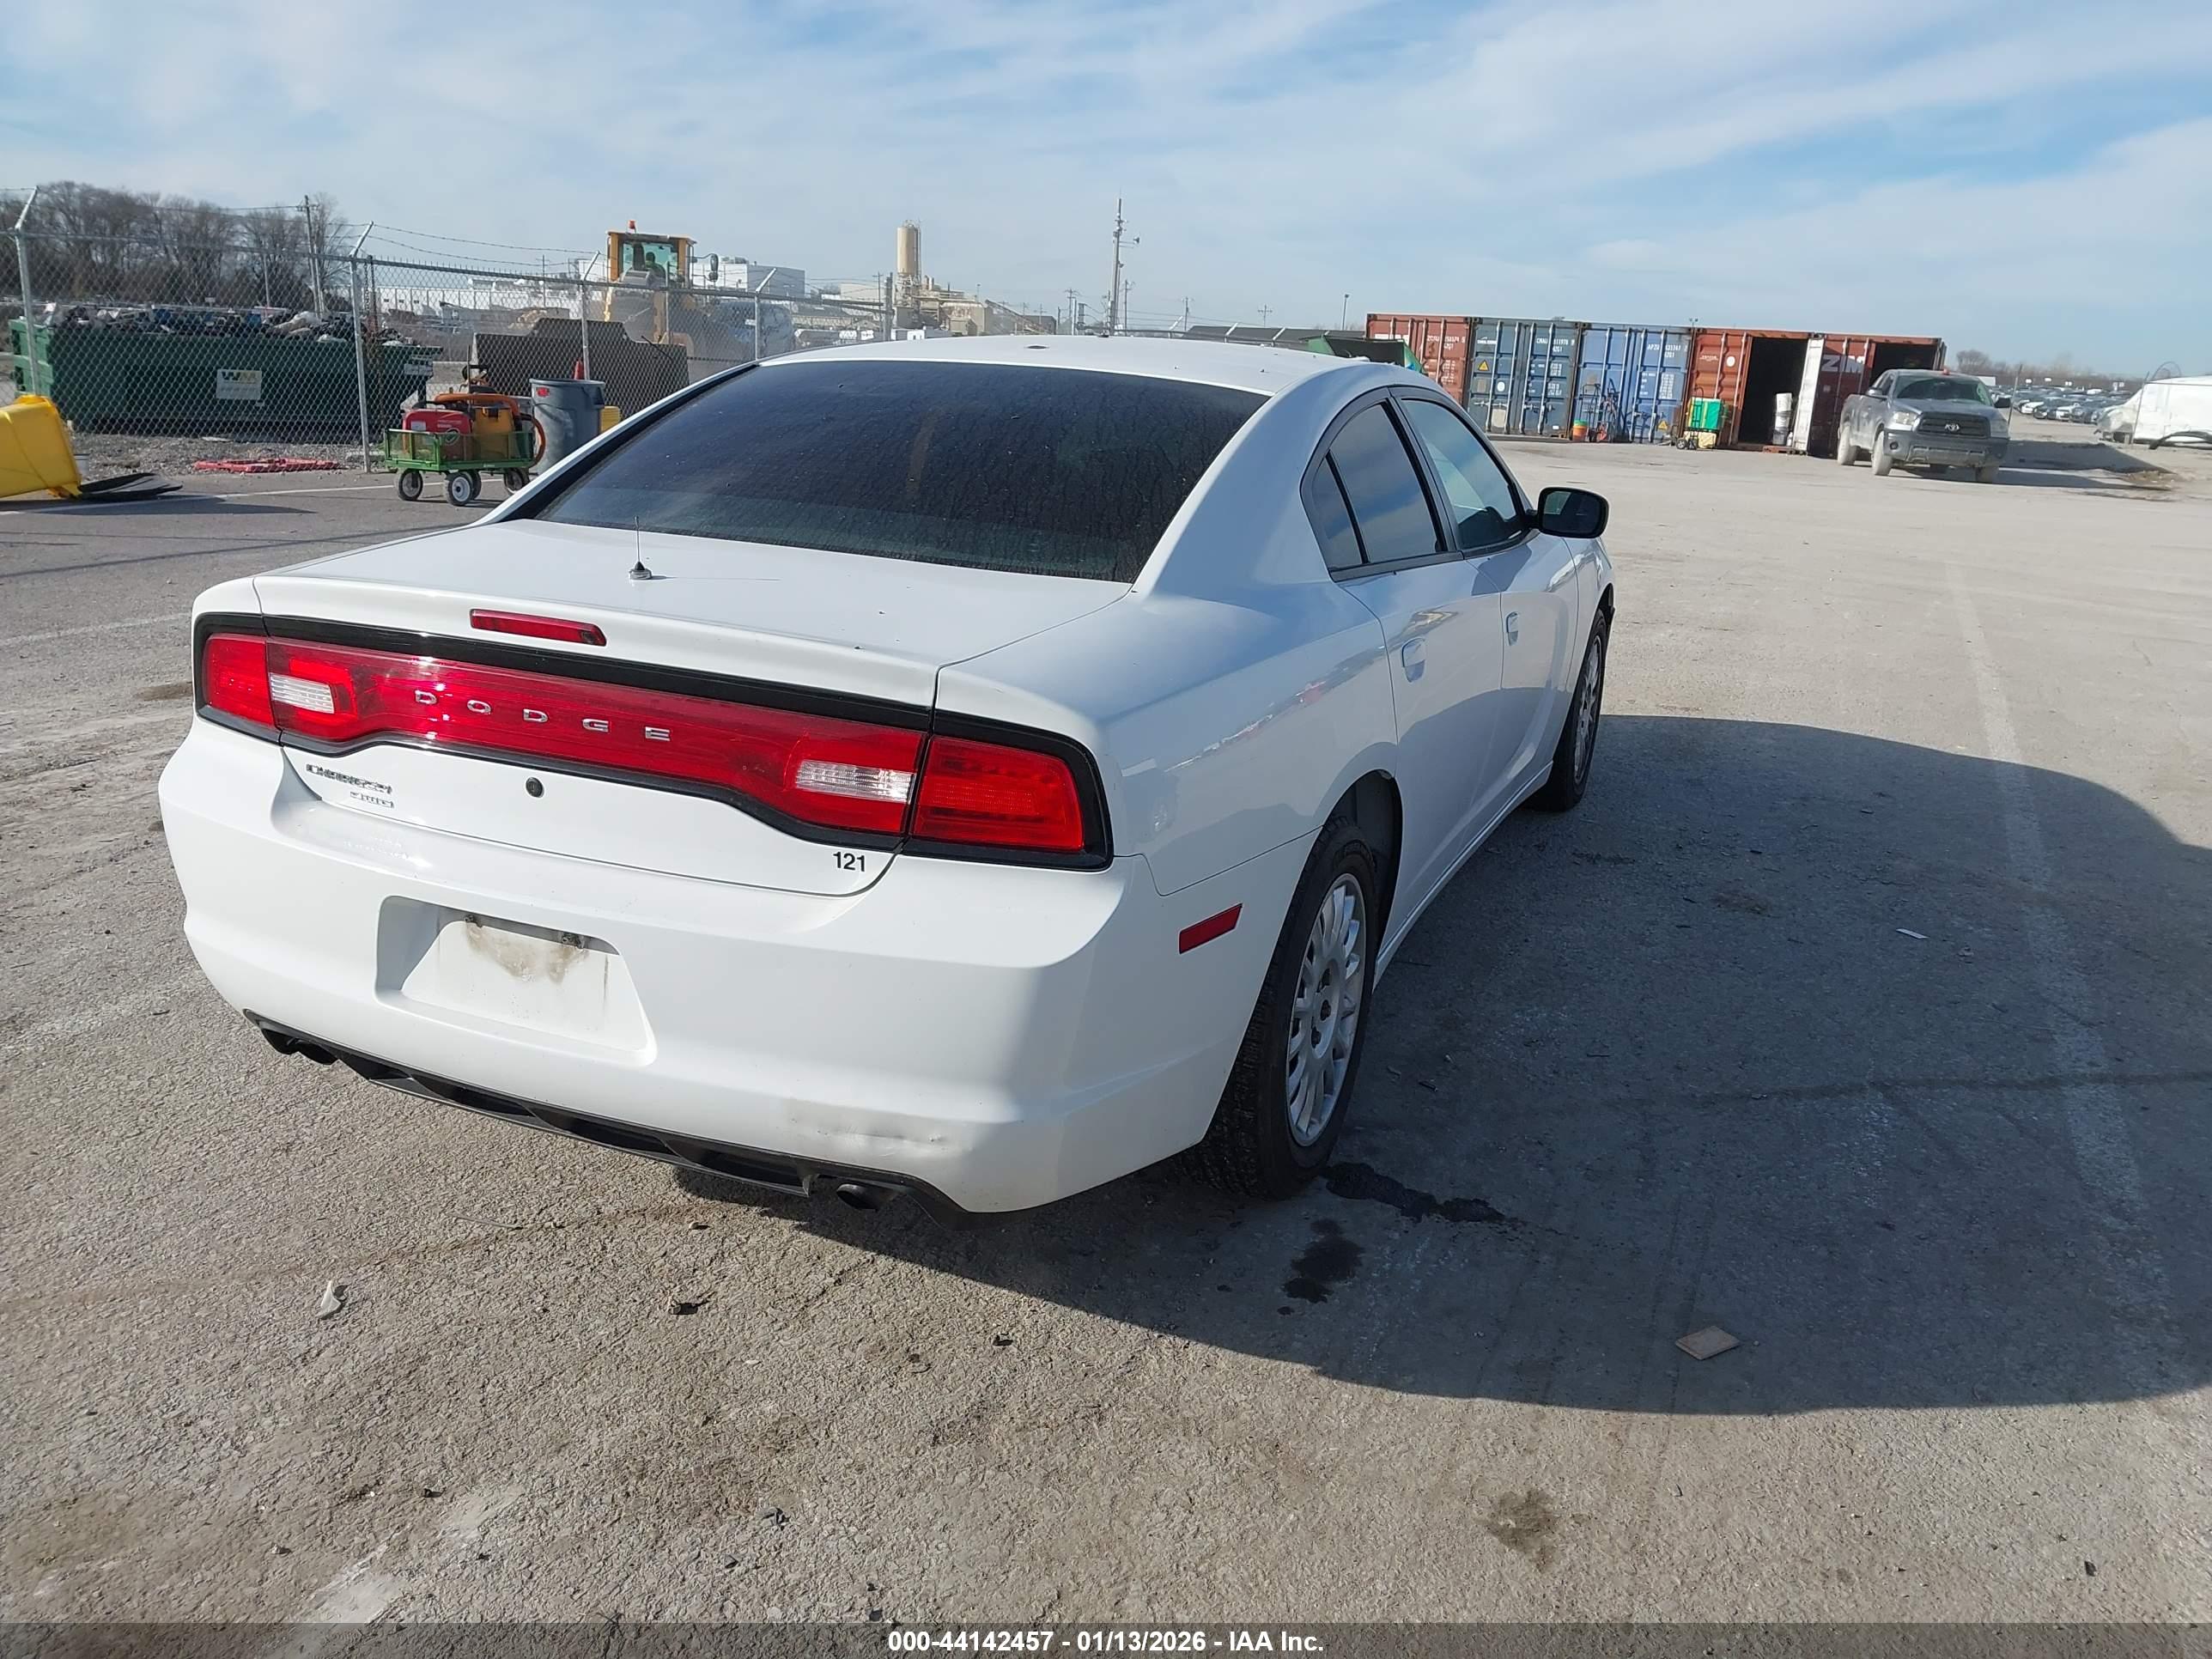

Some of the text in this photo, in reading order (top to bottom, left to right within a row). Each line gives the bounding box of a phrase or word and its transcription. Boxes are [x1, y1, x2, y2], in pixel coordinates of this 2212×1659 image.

[1820, 355, 1865, 373] ZIM
[415, 690, 671, 742] DODGE
[833, 851, 865, 872] 121
